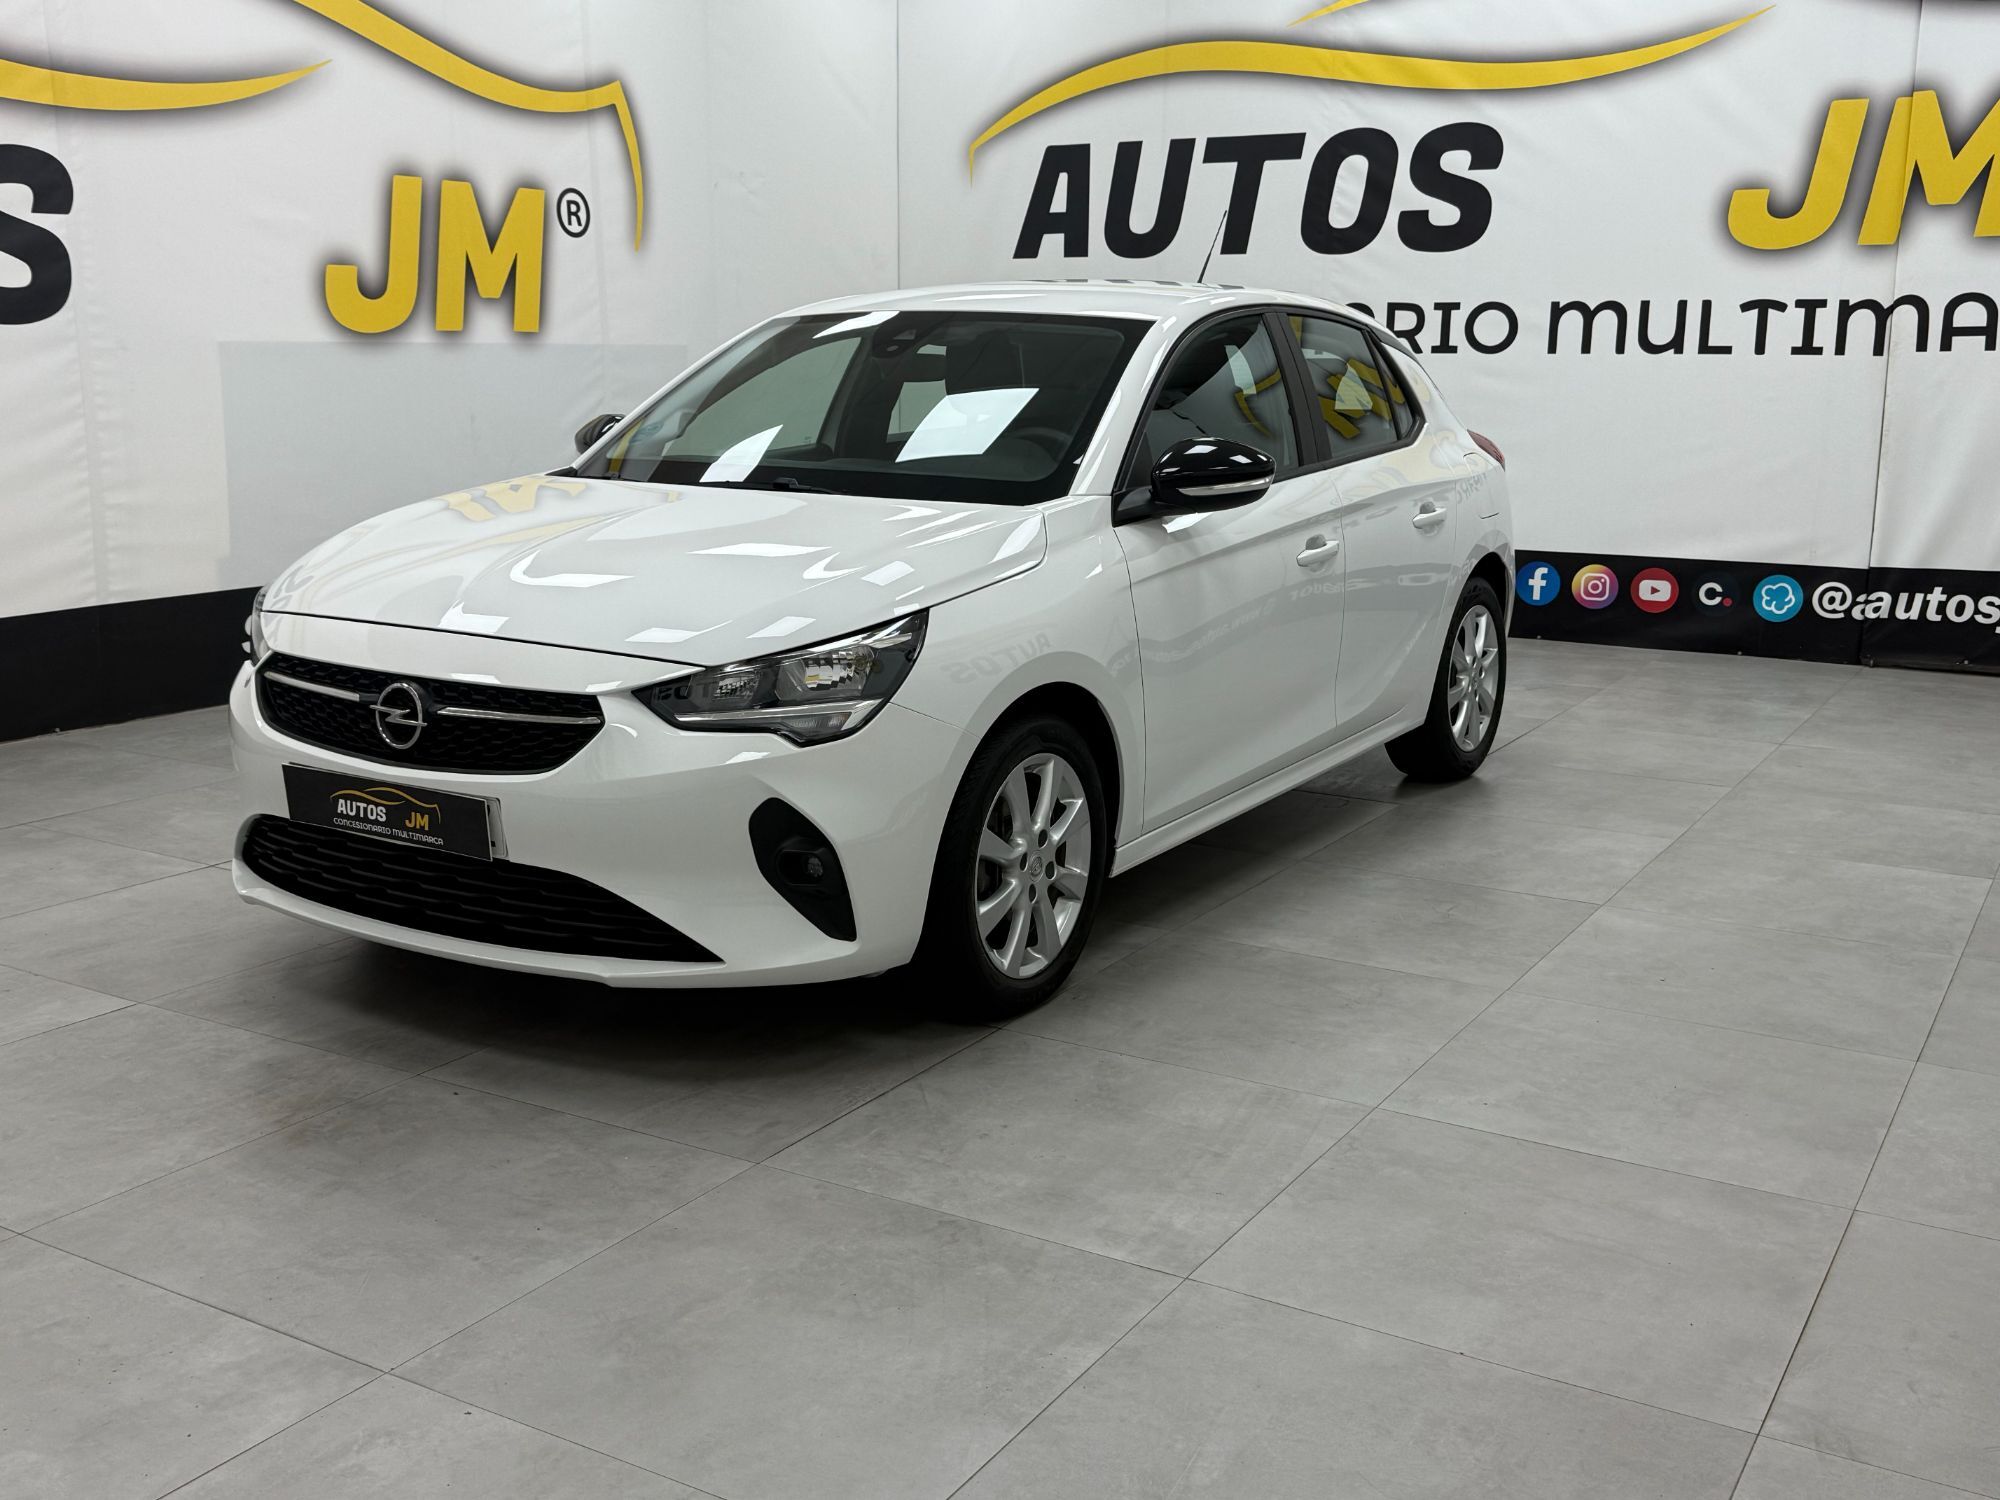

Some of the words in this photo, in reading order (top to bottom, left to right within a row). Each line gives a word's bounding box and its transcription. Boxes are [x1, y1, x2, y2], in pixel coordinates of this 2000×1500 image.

[1012, 121, 1504, 259] AUTOS
[337, 798, 387, 822] AUTOS
[405, 811, 429, 831] JM
[333, 817, 392, 835] CONCESIONARIO
[392, 827, 444, 846] MULTIMARCA
